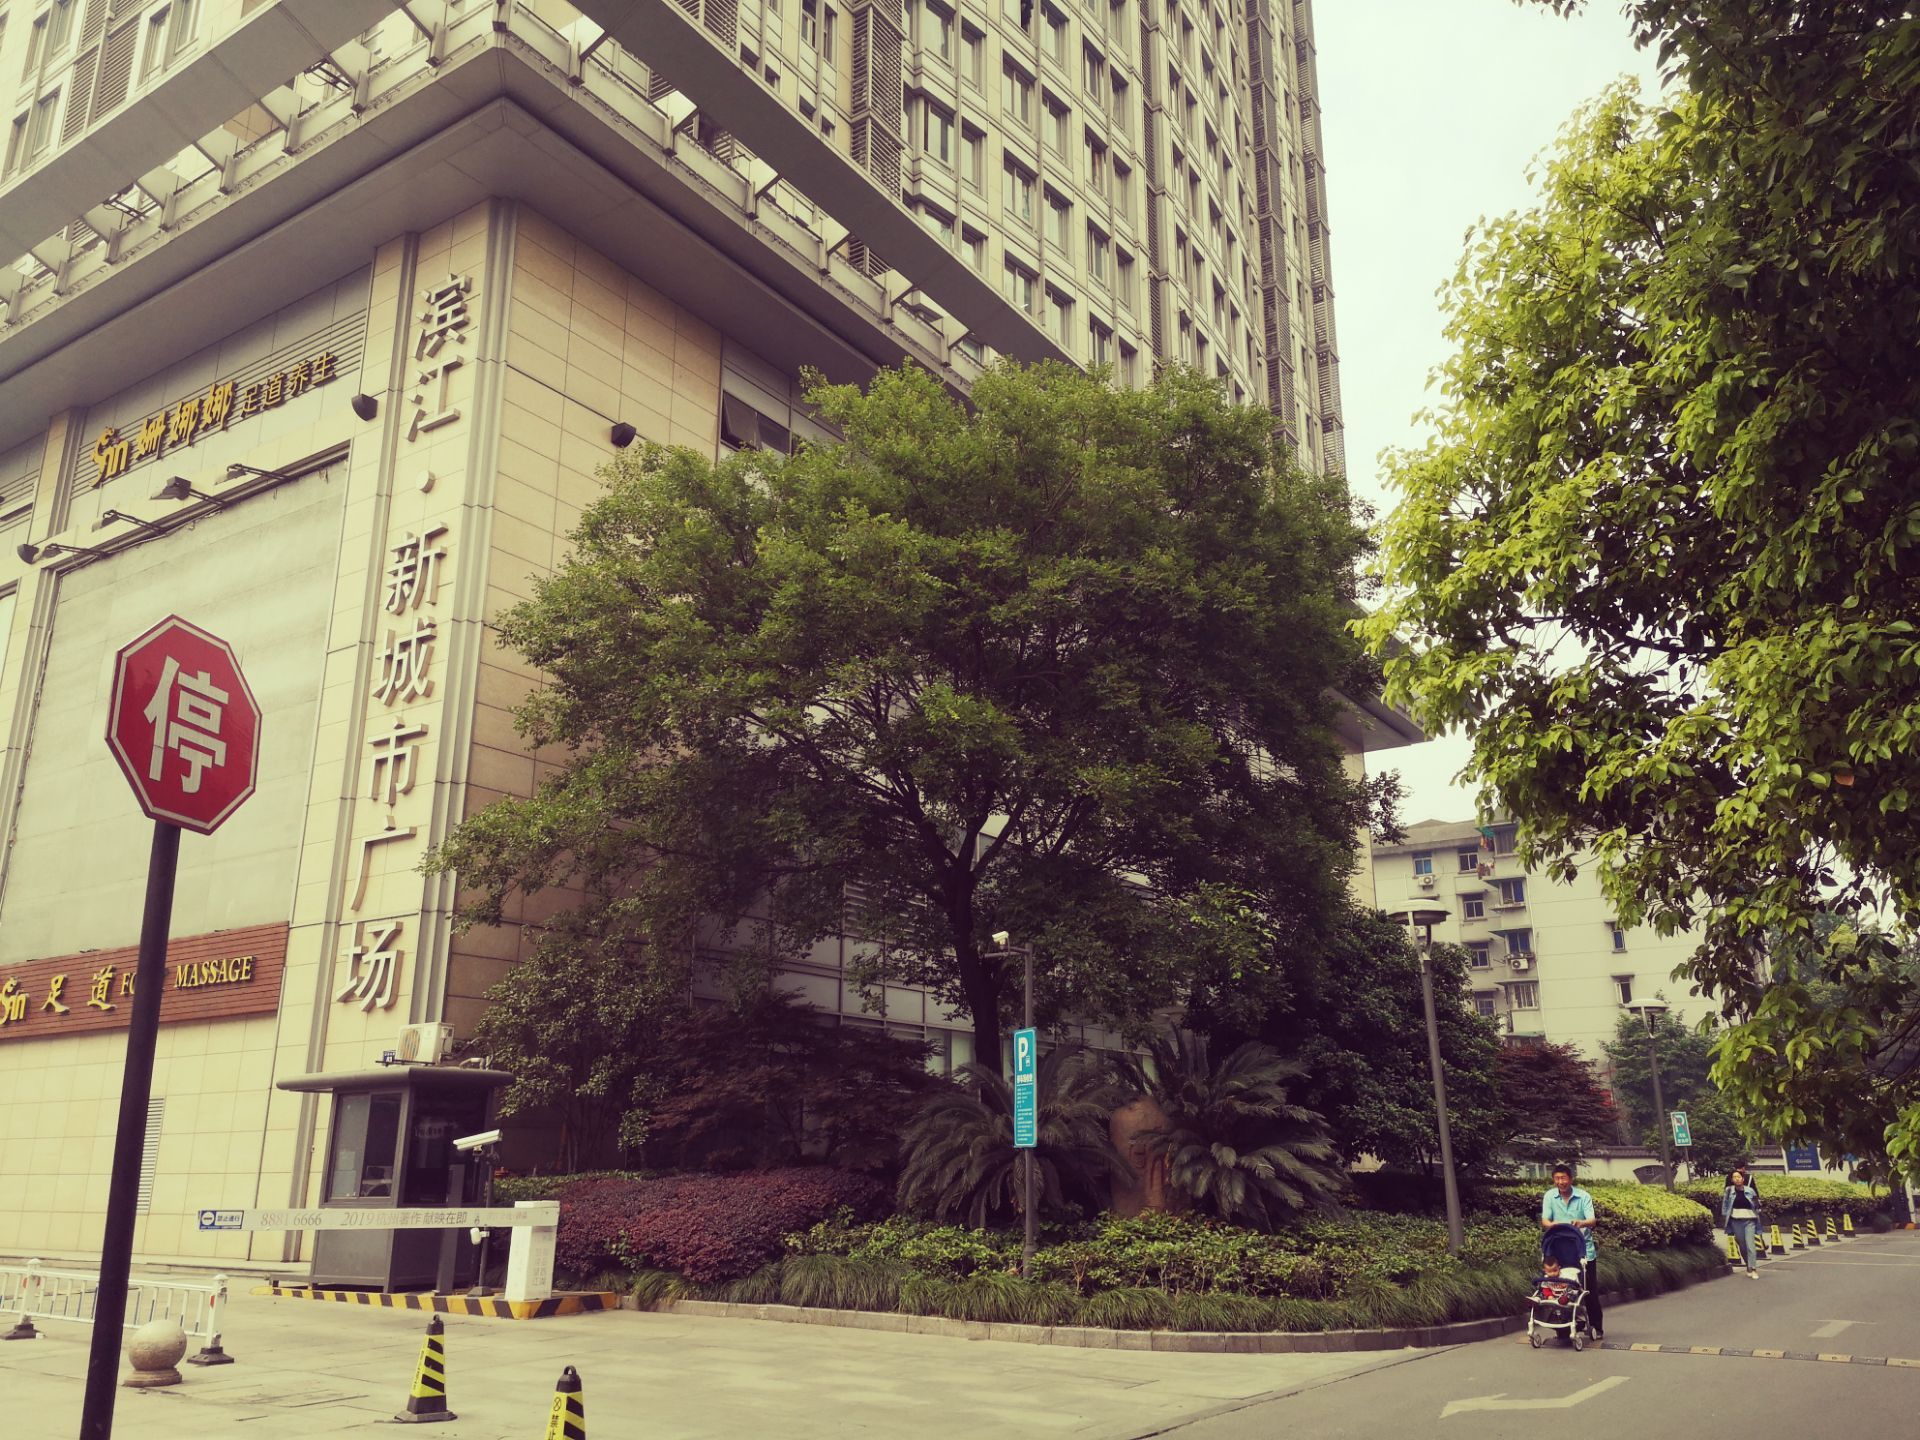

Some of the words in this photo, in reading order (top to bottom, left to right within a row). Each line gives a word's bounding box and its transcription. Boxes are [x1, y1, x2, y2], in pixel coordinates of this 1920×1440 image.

[241, 351, 338, 415] 足道养生
[143, 655, 230, 794] 停
[174, 955, 255, 990] MASSAGE
[1018, 1036, 1029, 1072] P
